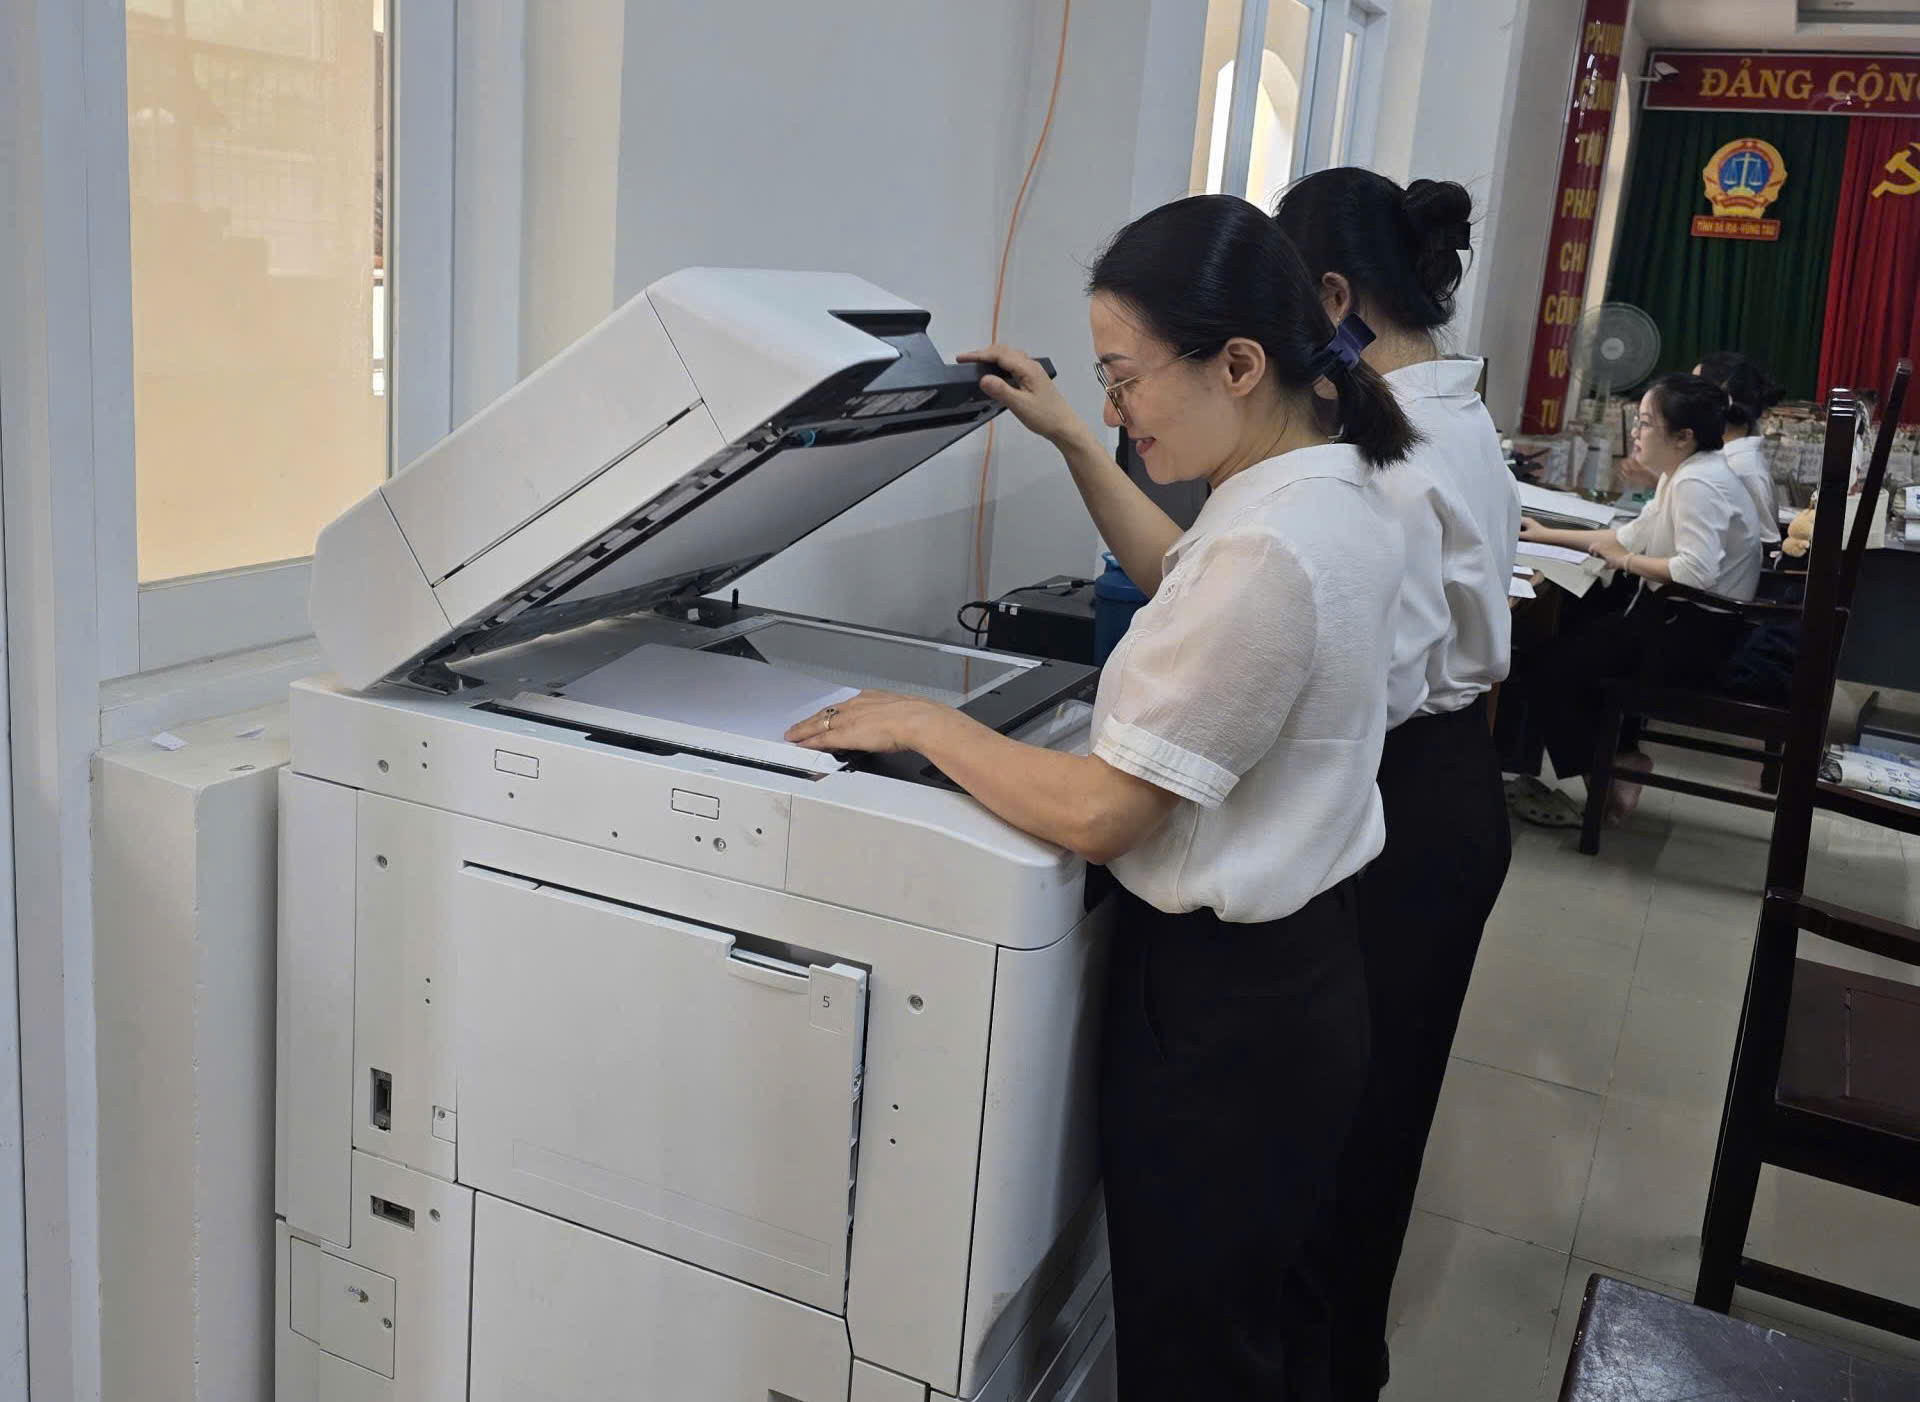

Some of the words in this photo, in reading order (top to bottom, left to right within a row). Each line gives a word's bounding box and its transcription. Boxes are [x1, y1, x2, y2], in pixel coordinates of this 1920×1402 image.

[1700, 58, 1814, 100] ĐẢNG
[1827, 63, 1920, 108] CỘN
[823, 995, 830, 1008] 5
